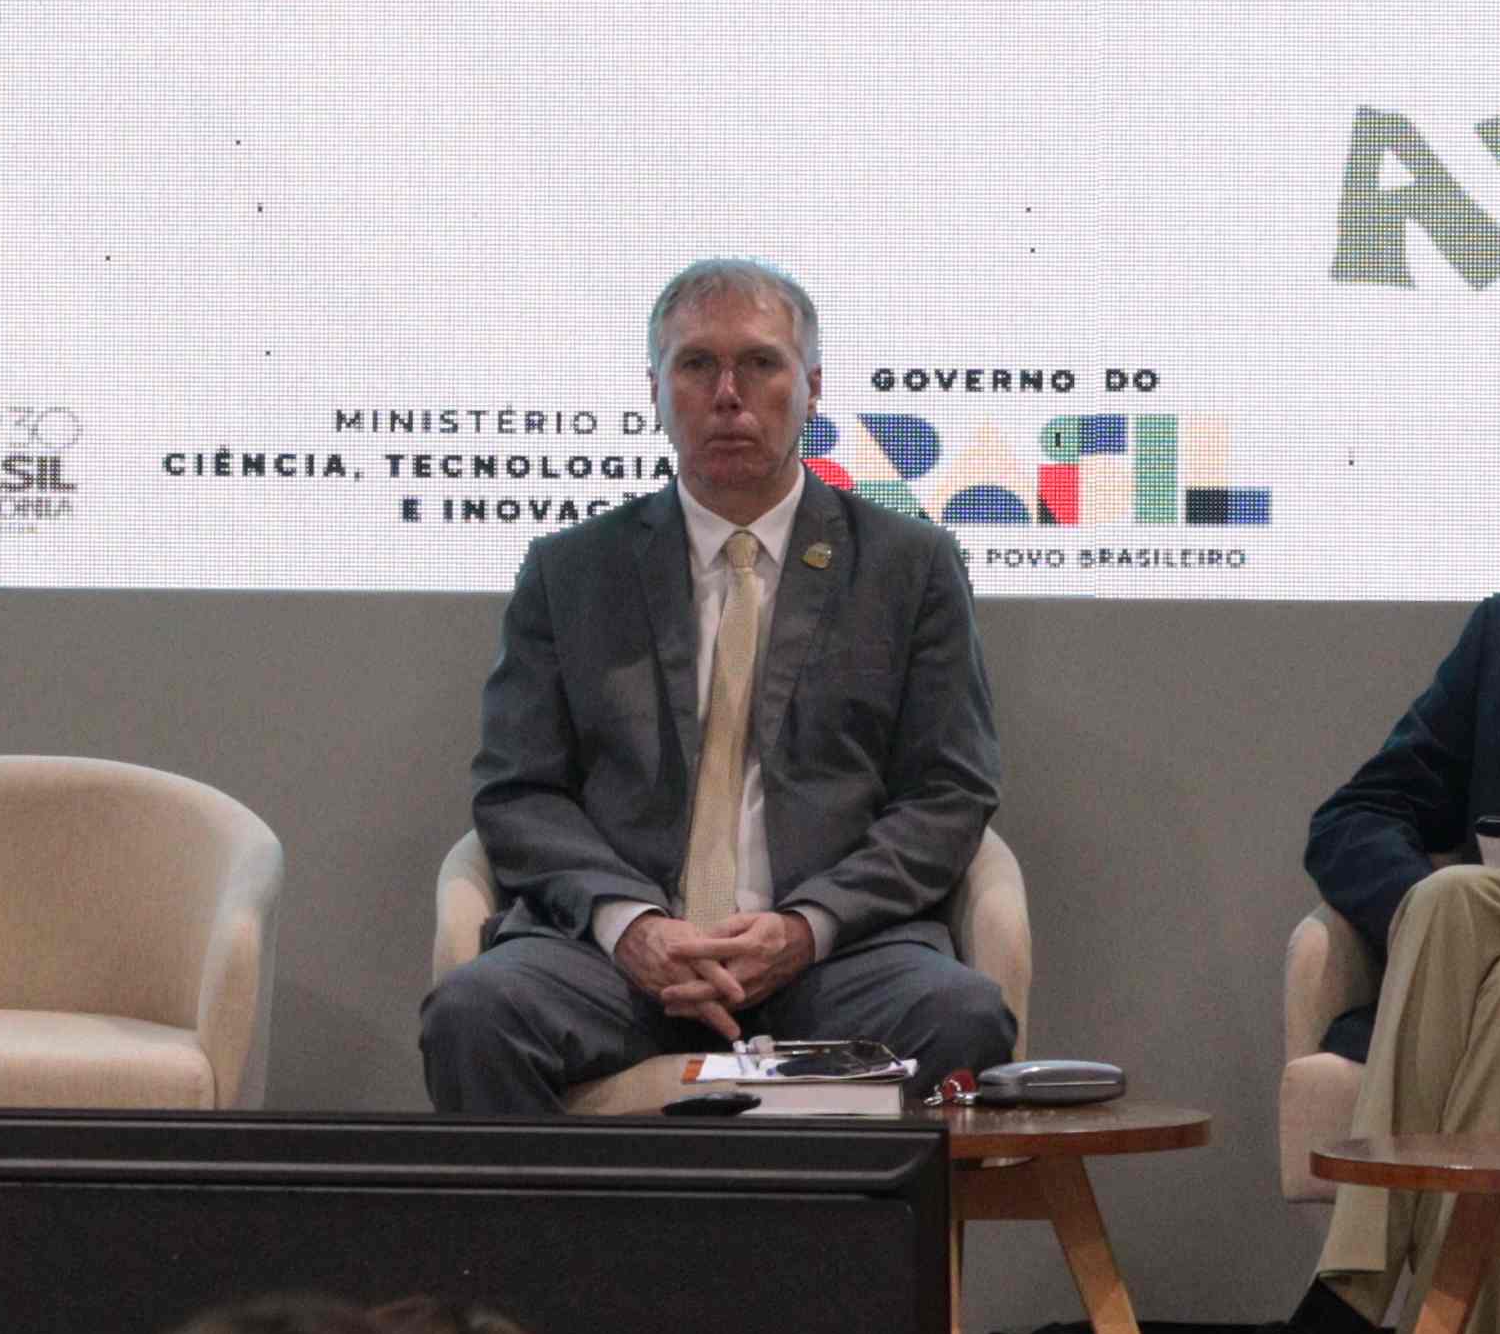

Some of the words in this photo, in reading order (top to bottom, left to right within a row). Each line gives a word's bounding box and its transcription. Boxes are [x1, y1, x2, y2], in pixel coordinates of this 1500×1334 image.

[870, 368, 1076, 393] GOVERNO
[1105, 368, 1160, 393] DO
[335, 404, 597, 435] MINISTÉRIO
[162, 444, 360, 481] CIÊNCIA,
[386, 454, 676, 480] TECNOLOGIA
[401, 497, 421, 523] E
[986, 548, 1065, 567] POVO
[1079, 548, 1246, 567] BRASILEIRO
